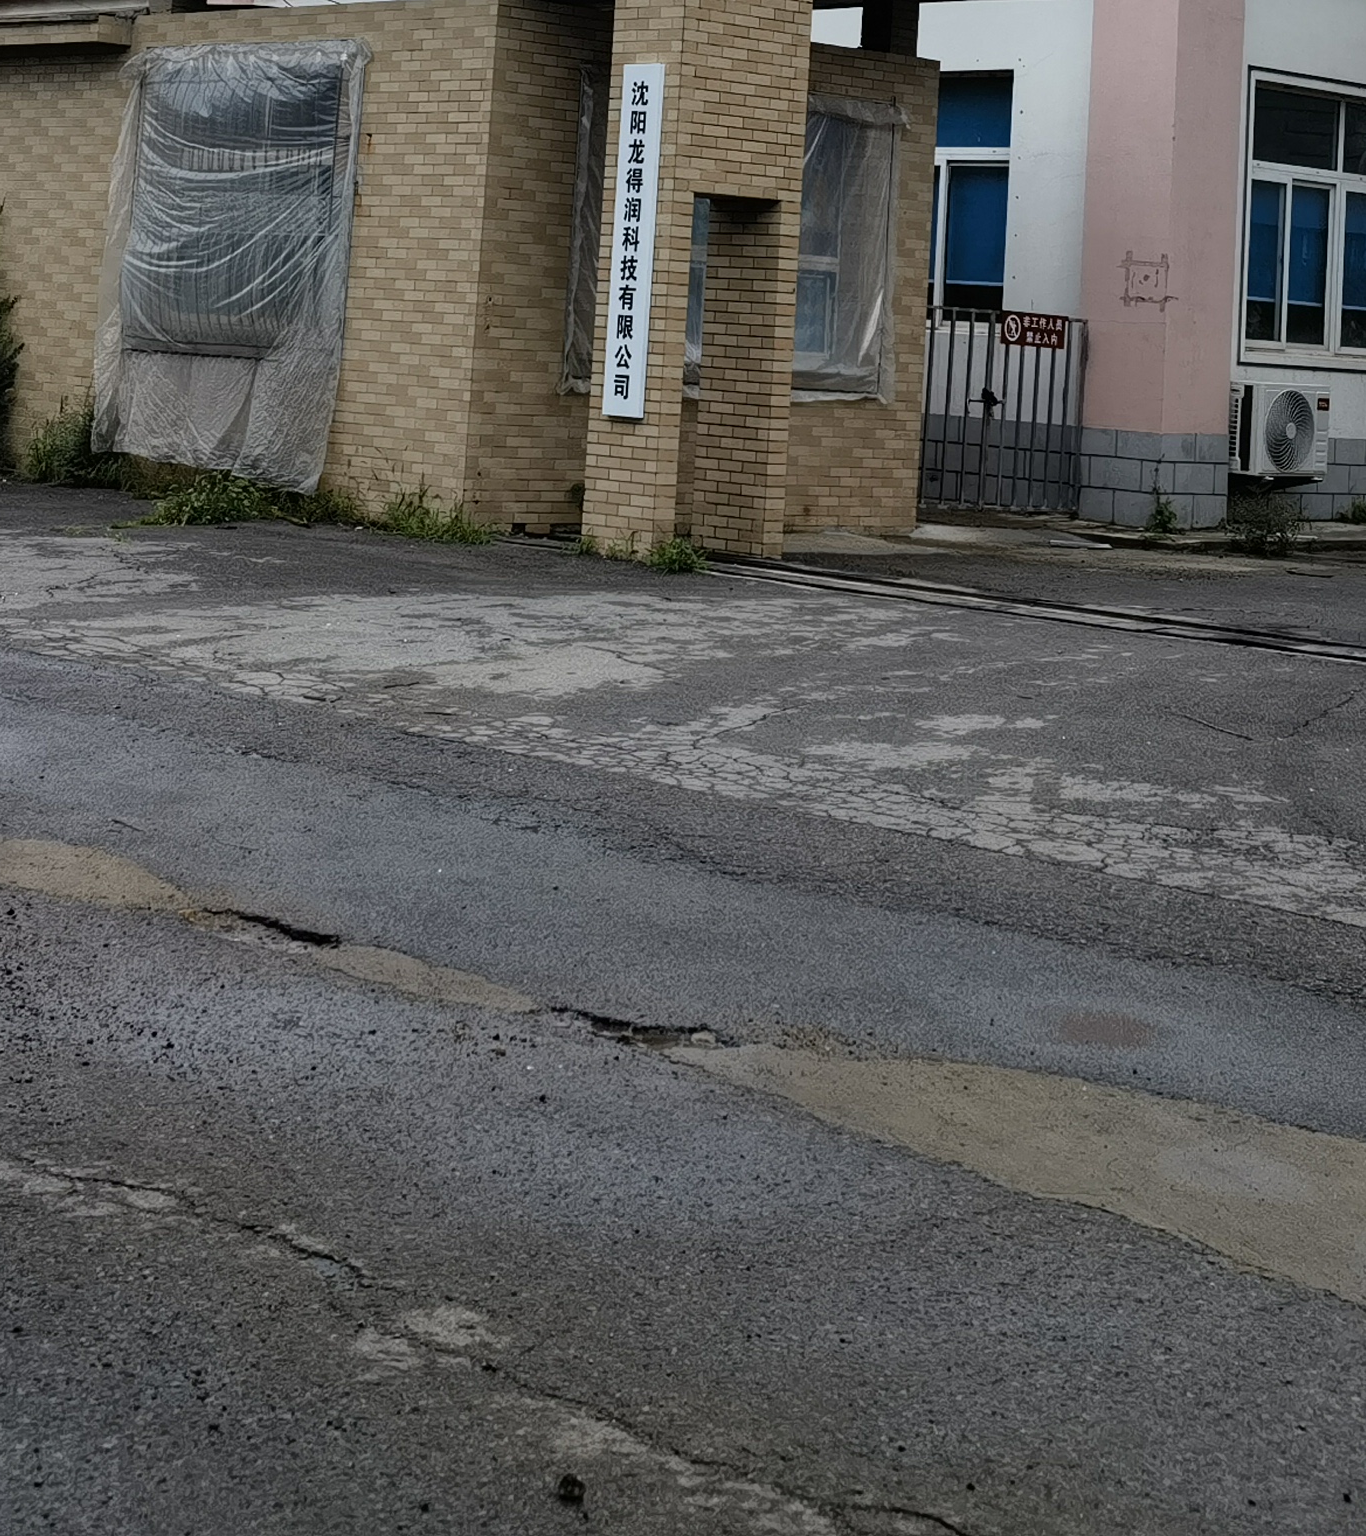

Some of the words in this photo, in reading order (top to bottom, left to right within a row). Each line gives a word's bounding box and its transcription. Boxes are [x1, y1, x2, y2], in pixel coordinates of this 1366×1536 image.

[613, 80, 649, 400] 沈阳龙得润科技有限公司
[1022, 315, 1063, 332] 非工作人员
[1026, 331, 1058, 346] 禁止入内
